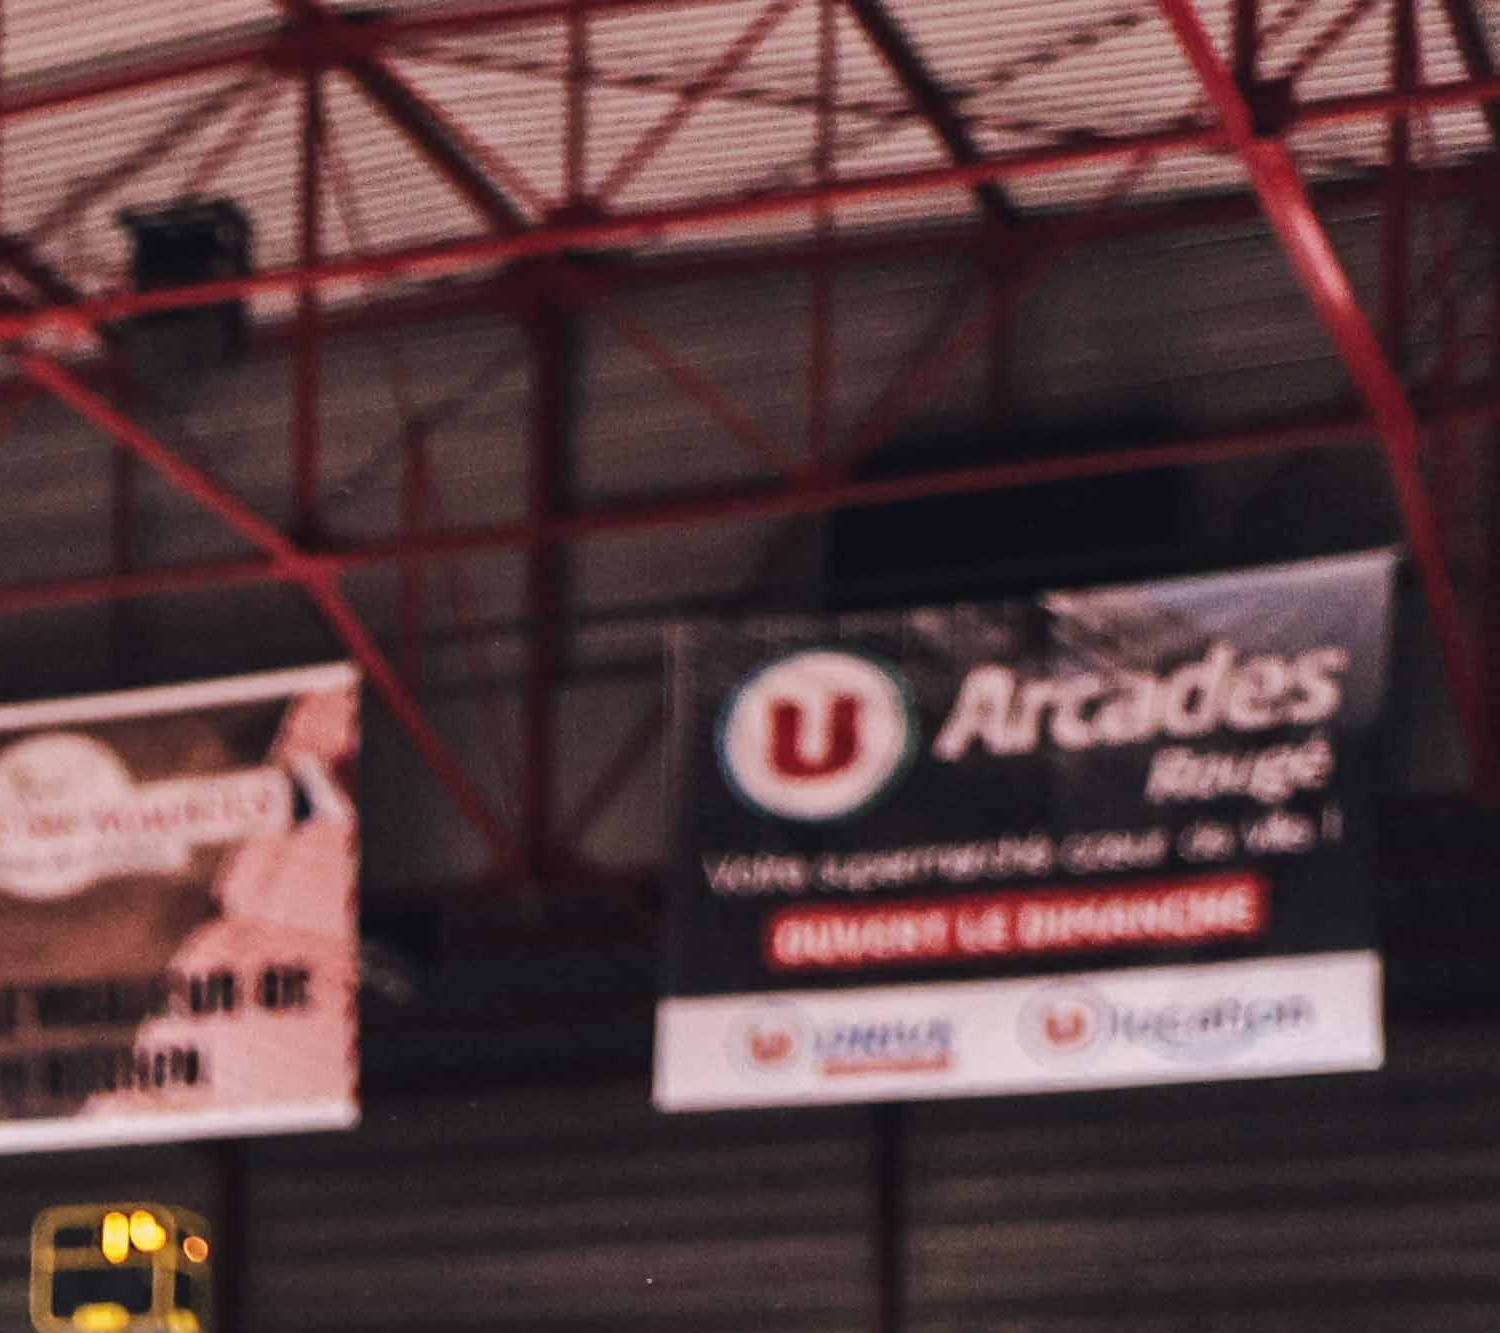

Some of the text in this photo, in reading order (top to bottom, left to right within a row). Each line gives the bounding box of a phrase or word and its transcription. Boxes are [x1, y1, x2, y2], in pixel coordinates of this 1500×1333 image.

[768, 694, 863, 783] U
[937, 643, 1349, 760] Arcades
[954, 903, 1006, 954] LE
